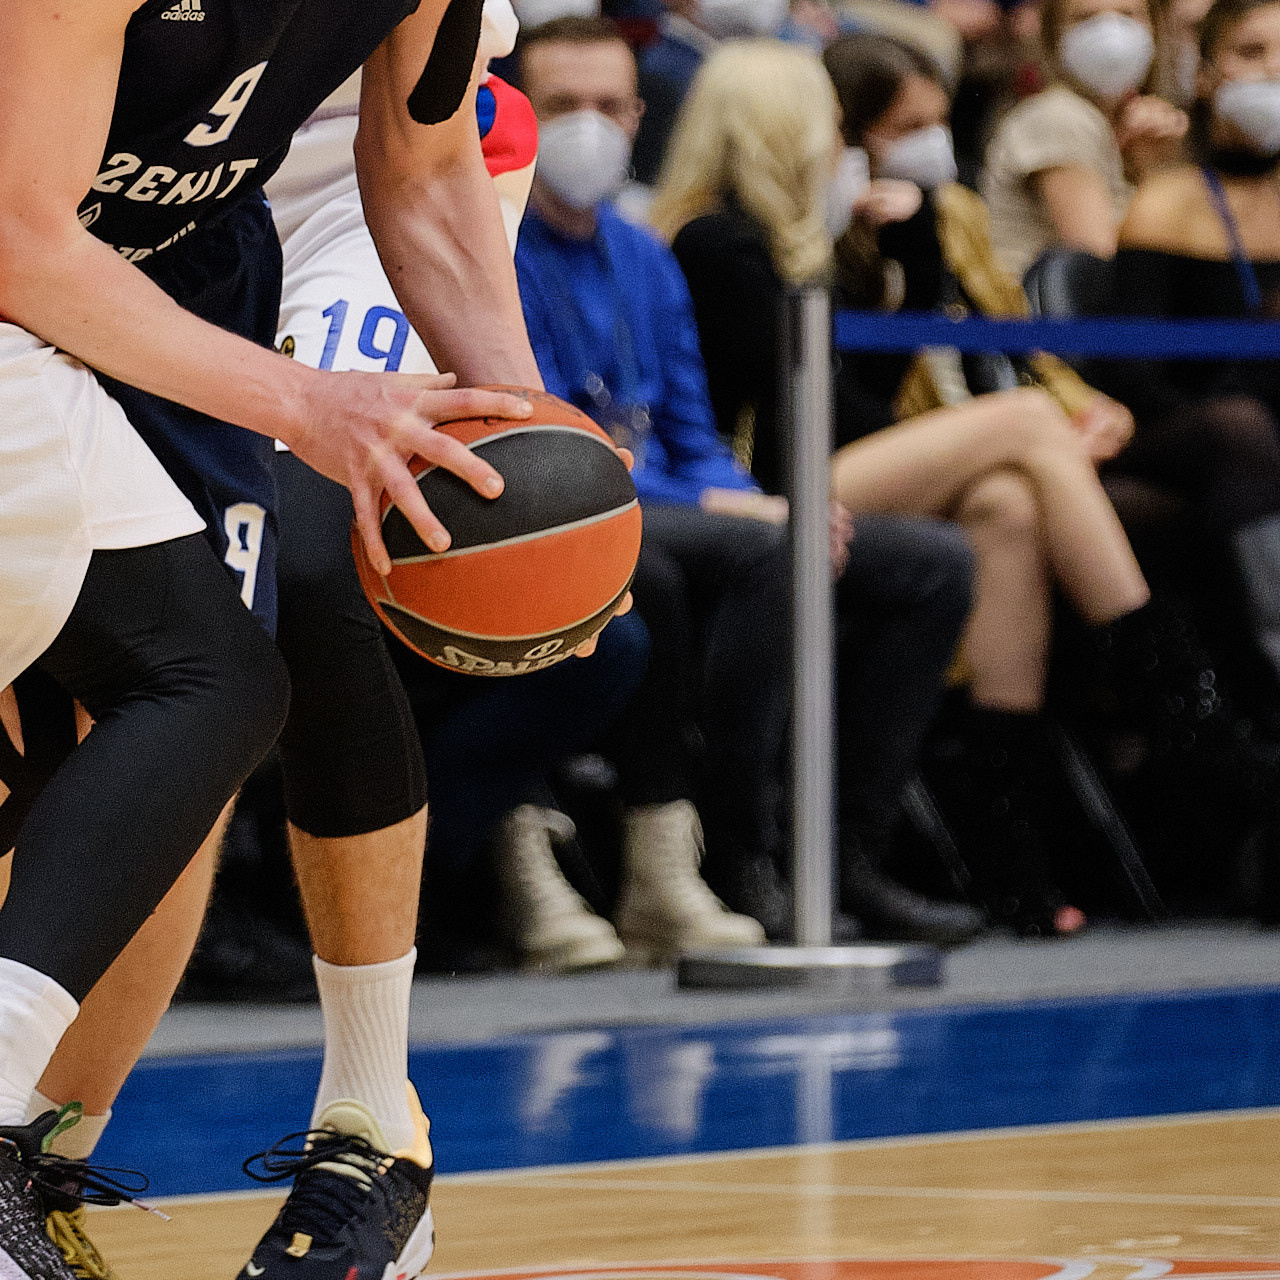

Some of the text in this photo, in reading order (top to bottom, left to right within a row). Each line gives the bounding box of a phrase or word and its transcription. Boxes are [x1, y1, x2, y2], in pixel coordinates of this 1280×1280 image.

[160, 9, 206, 22] adidas
[183, 60, 268, 147] 9
[91, 152, 260, 206] ZENIT
[318, 298, 410, 373] 19
[223, 501, 267, 611] 9
